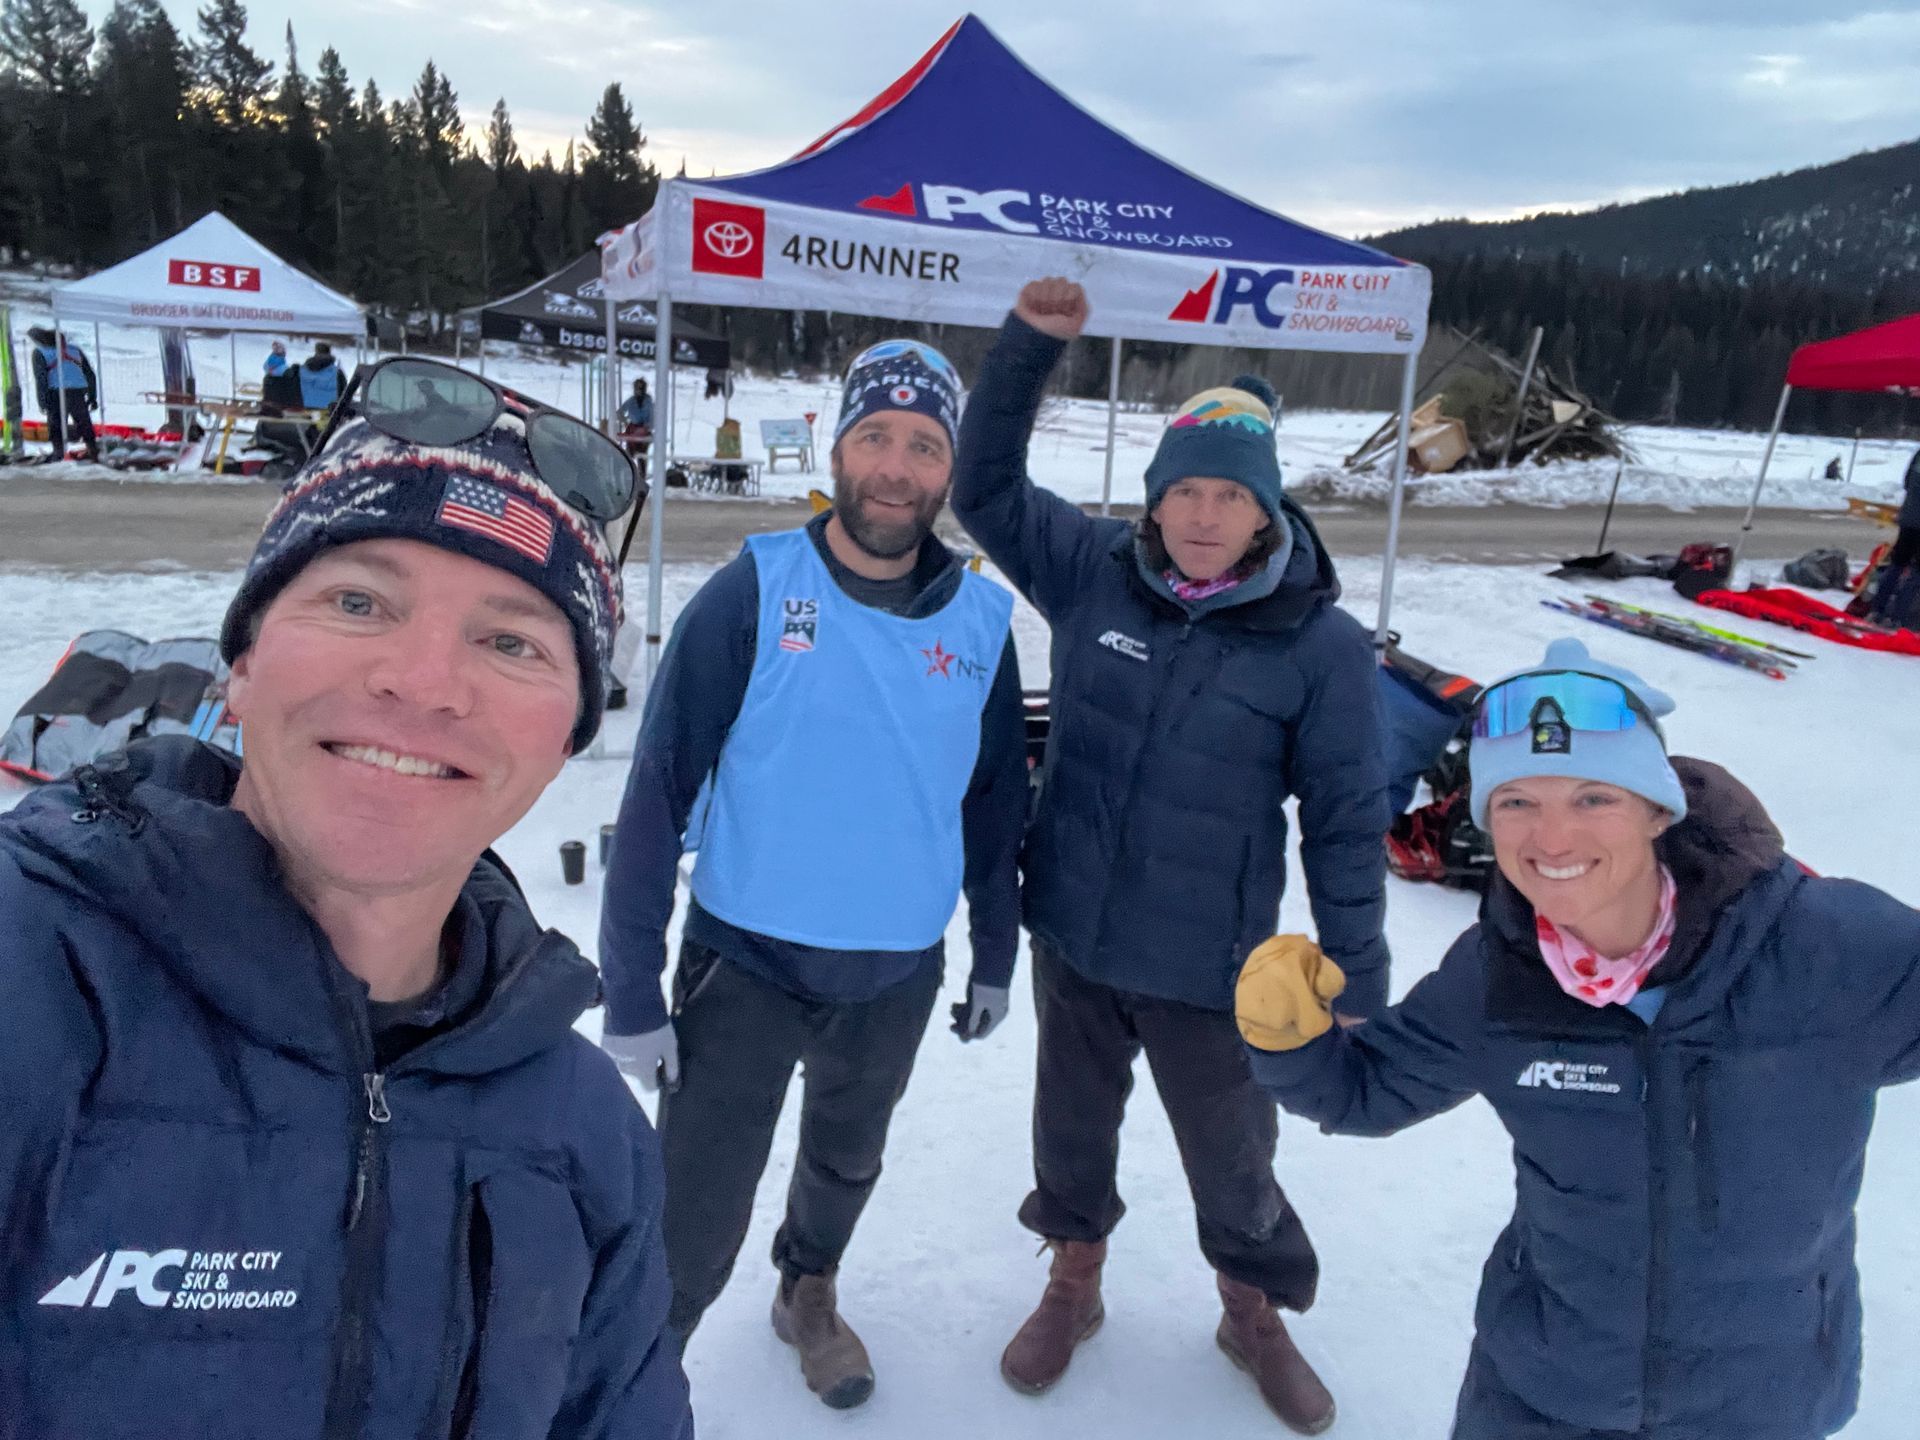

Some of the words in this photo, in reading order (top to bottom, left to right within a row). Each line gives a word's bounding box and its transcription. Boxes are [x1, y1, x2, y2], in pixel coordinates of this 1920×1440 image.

[922, 183, 1040, 234] PC
[1040, 193, 1112, 216] PARK
[1117, 203, 1174, 219] CITY
[1042, 210, 1083, 226] SKI
[1092, 216, 1111, 230] &
[1047, 225, 1233, 249] SNOWBOARD
[781, 234, 960, 283] 4RUNNER
[183, 264, 250, 288] BSF
[1301, 272, 1347, 290] PARK
[1353, 274, 1391, 290] CITY
[1213, 267, 1294, 329] PC
[1294, 292, 1321, 310] SKI
[1326, 293, 1340, 311] &
[131, 303, 189, 318] BRIDGER
[214, 304, 294, 322] FOUNDATION
[1288, 313, 1409, 333] SNOWBOARD
[785, 599, 816, 616] US
[1533, 1061, 1564, 1089] PC
[1588, 1064, 1608, 1075] CITY
[190, 1251, 238, 1270] PARK
[241, 1251, 282, 1270] CITY
[91, 1249, 187, 1308] PC
[181, 1272, 211, 1290] SKI
[215, 1272, 229, 1290] &
[173, 1290, 297, 1310] SNOWBOARD
